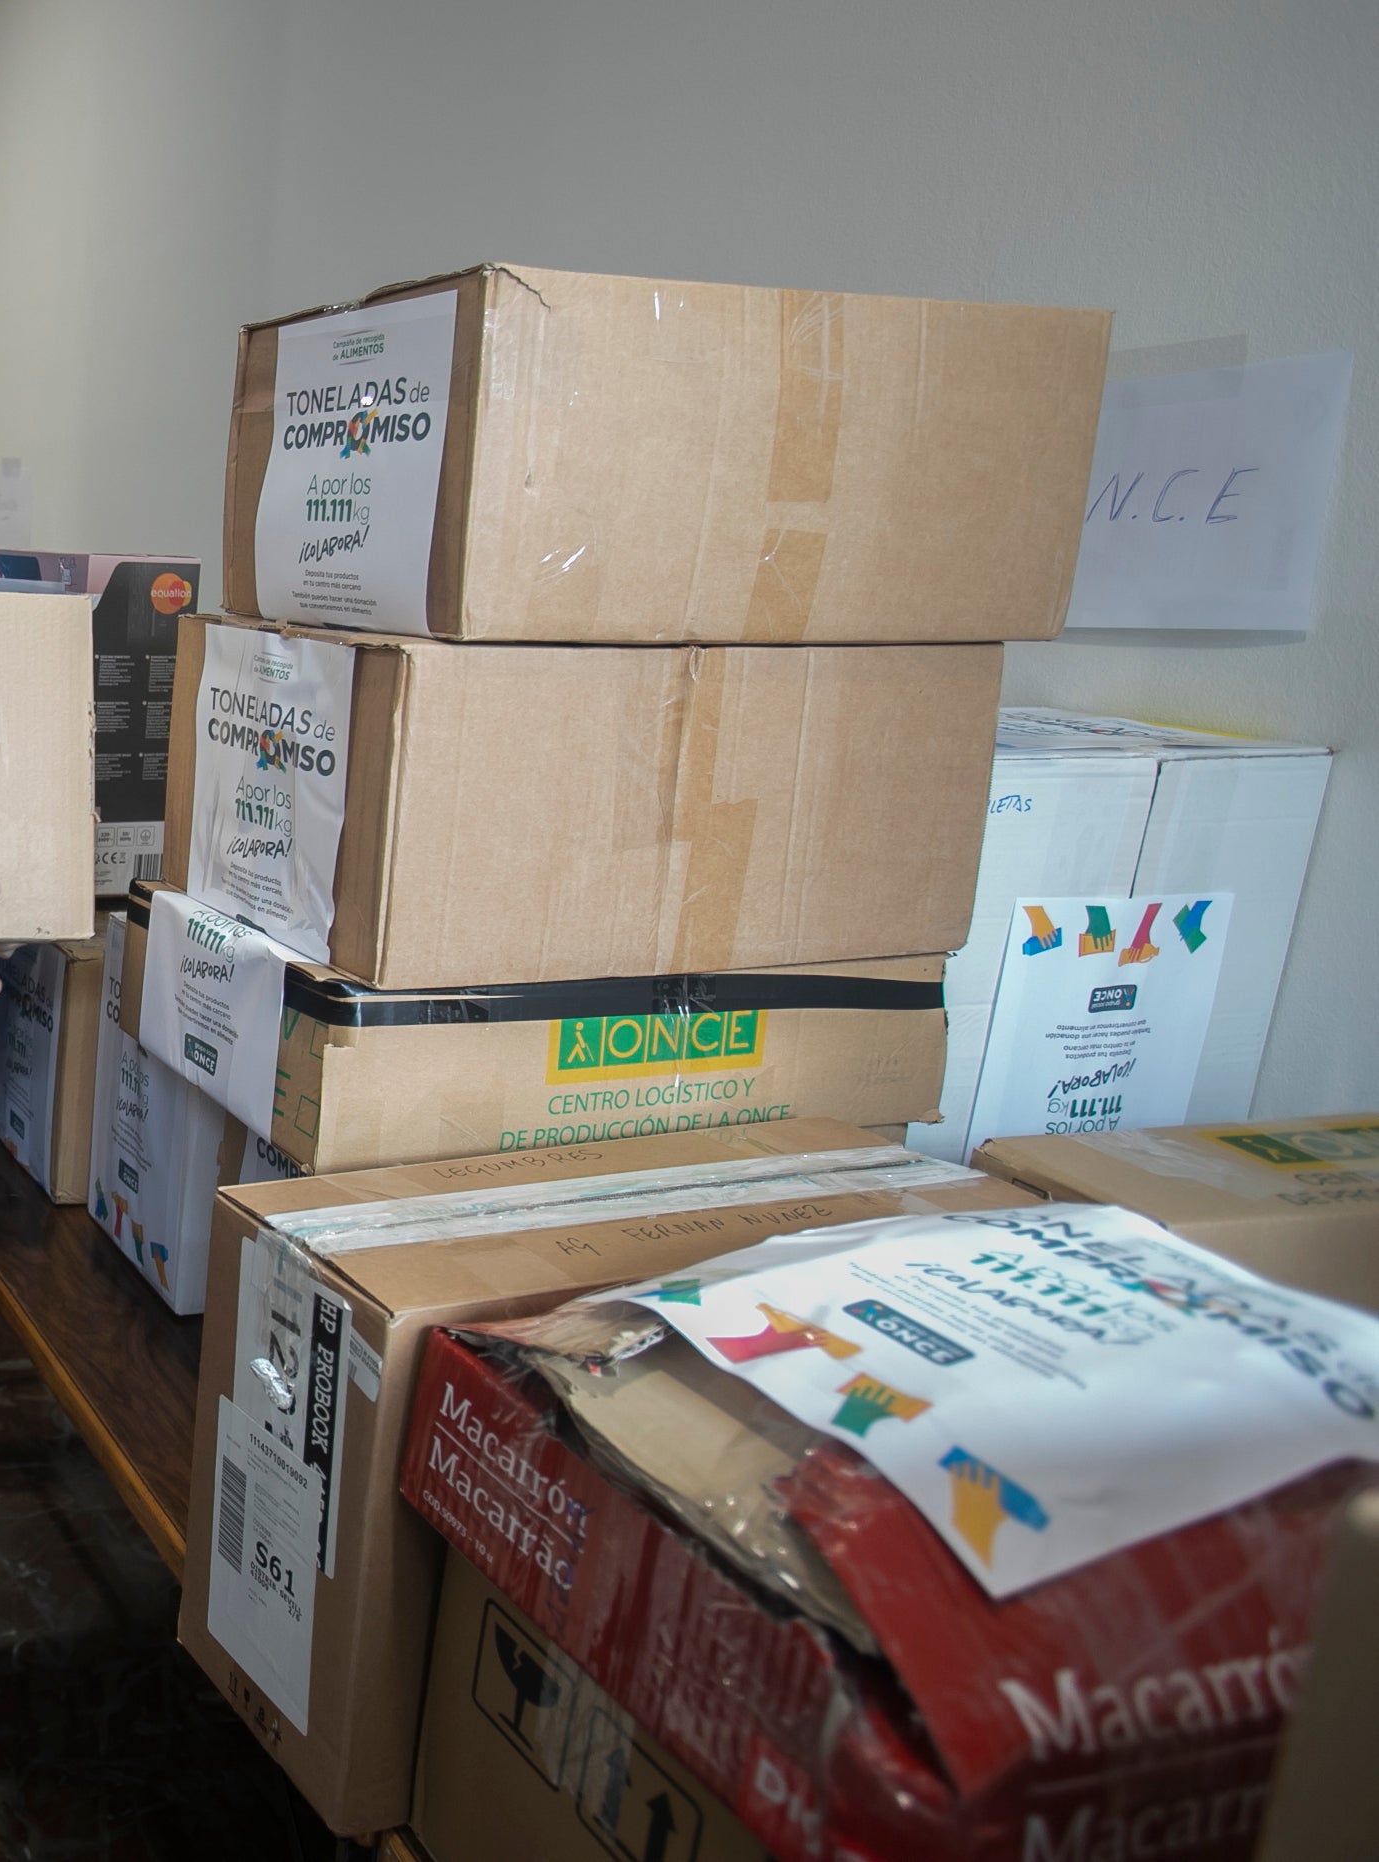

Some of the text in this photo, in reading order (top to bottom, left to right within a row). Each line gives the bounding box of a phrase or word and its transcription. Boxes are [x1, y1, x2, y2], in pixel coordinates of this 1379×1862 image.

[340, 342, 384, 360] ALIMENTOS
[287, 376, 430, 416] TONELADAS de
[283, 411, 431, 450] COMPROMISO
[307, 472, 371, 499] A por los
[150, 588, 192, 598] equation
[210, 687, 313, 735] TONELADAS
[313, 720, 335, 742] de
[208, 718, 335, 776] COMPROMISO
[236, 776, 291, 810] A por los
[987, 794, 1033, 814] LETAS
[1093, 988, 1122, 1002] ONCE
[607, 1010, 753, 1058] ONCE
[1045, 1032, 1081, 1040] donación
[1057, 1024, 1089, 1032] alimento
[193, 1050, 215, 1072] ONCE
[1065, 1051, 1097, 1060] productos
[547, 1077, 756, 1116] CENTRO LOGÍSTICO Y
[499, 1130, 528, 1152] DE
[532, 1114, 671, 1149] PRODUCCIÓN
[675, 1115, 703, 1133] DE
[736, 1104, 791, 1126] ONCE
[433, 1150, 603, 1179] LEGUMBRES
[621, 1218, 725, 1242] FERNAN
[319, 1298, 338, 1334] HP
[941, 1215, 1374, 1421] COMPROMISO
[875, 1318, 958, 1364] ONCE
[311, 1342, 334, 1454] PROBOOK
[249, 1433, 308, 1490] 11143710019092
[439, 1381, 588, 1538] Macarrón
[428, 1435, 572, 1590] Macarrão
[255, 1540, 295, 1598] S61
[279, 1590, 302, 1616] SEVILL
